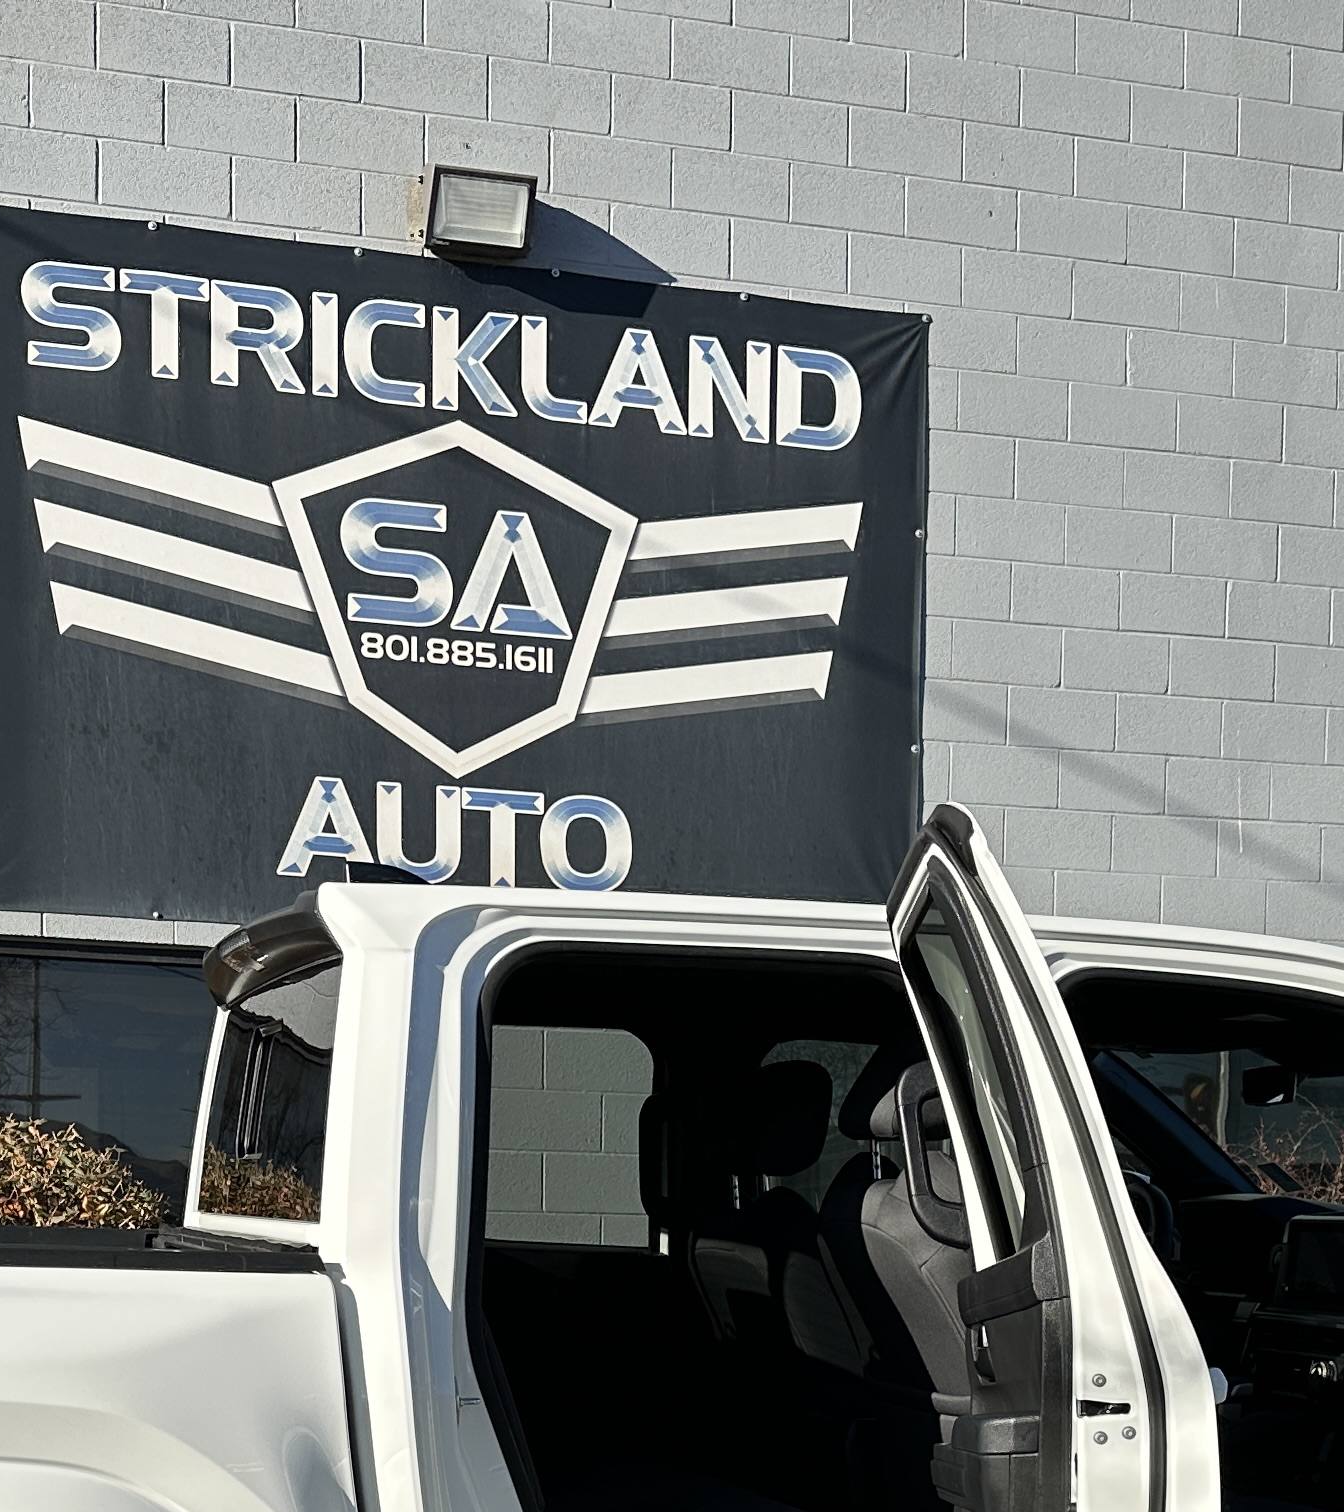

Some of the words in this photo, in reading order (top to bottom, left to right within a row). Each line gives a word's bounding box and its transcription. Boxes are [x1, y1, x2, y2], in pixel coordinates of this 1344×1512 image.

[20, 260, 863, 452] STRICKLAND
[340, 497, 573, 640] SA
[360, 632, 554, 674] 801.885.1611
[276, 776, 633, 891] AUTO
